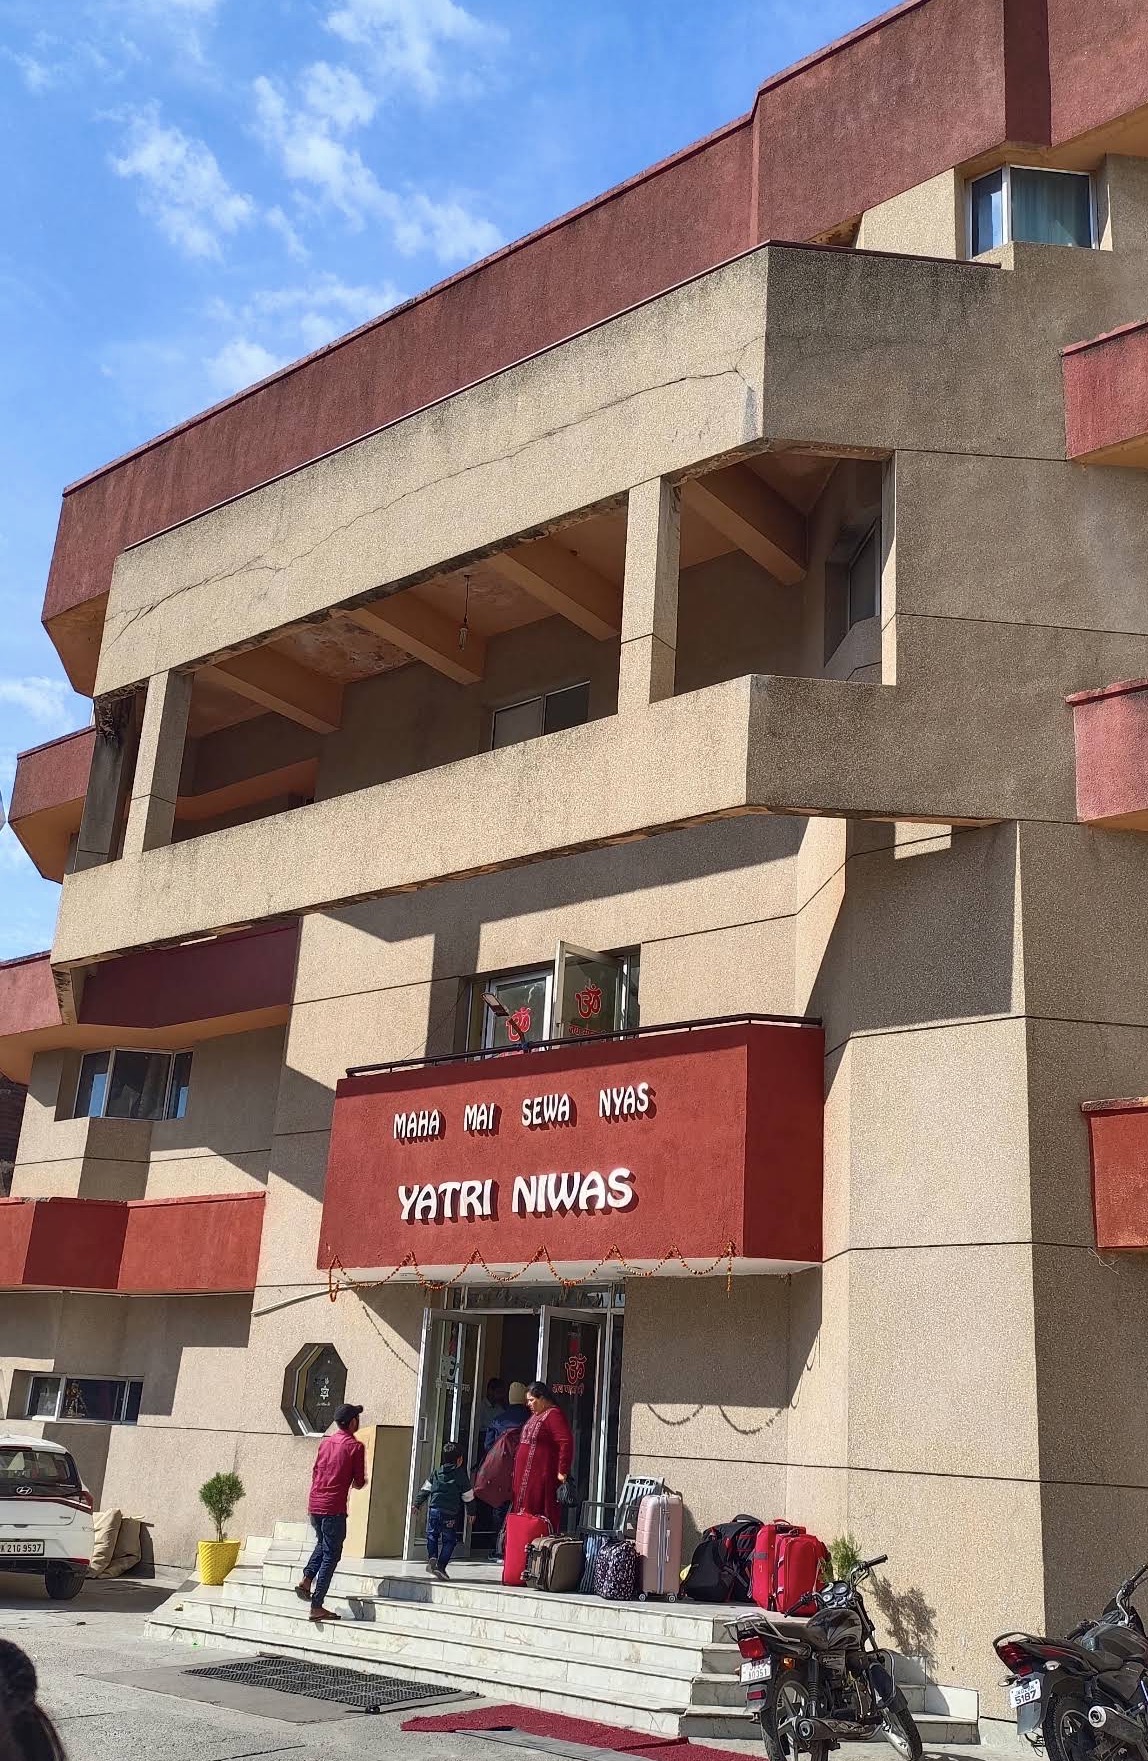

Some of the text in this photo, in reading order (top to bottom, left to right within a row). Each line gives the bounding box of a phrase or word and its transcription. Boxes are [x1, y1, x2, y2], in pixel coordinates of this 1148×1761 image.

[393, 1081, 650, 1139] MAHA MAI SEWA NYAS
[398, 1167, 633, 1220] YATRI NIWAS
[22, 1544, 41, 1552] 9537
